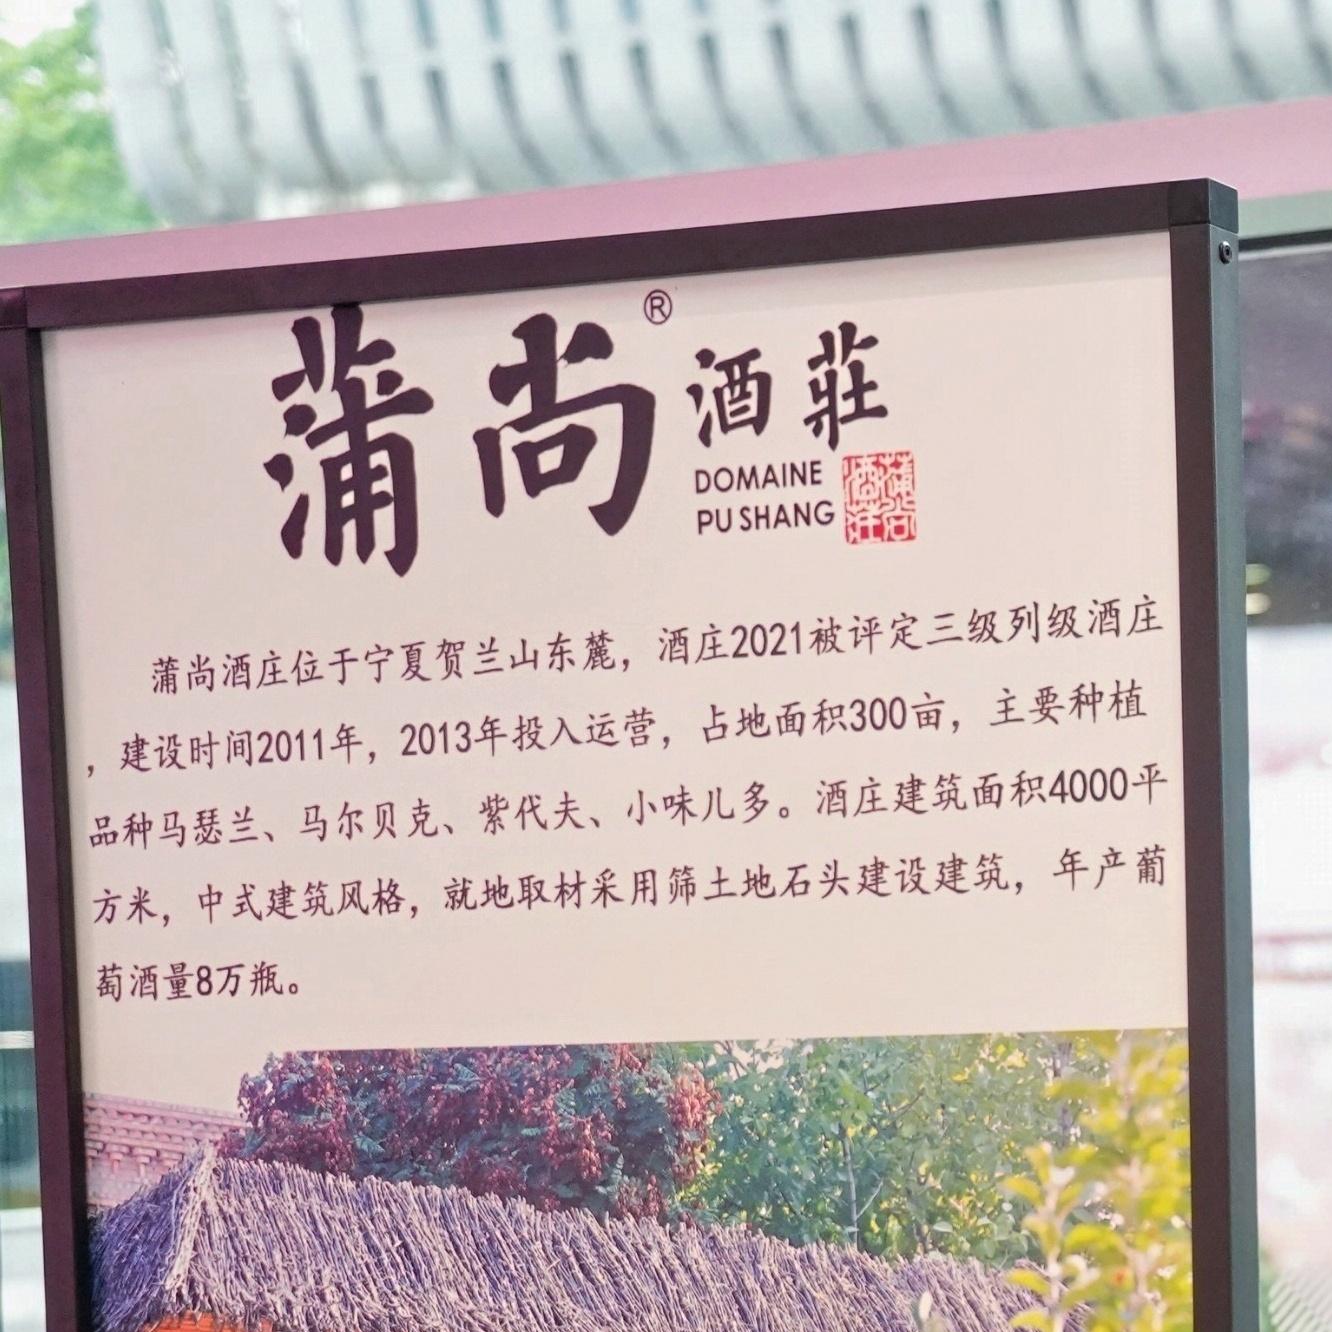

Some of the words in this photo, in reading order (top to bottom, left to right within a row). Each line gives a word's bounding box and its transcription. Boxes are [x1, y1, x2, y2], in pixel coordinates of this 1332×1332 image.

[264, 302, 657, 577] 蒲尚
[686, 321, 888, 451] 酒莊
[694, 459, 823, 495] DOMAINE
[697, 506, 732, 535] PU
[739, 499, 836, 532] SHANG
[96, 961, 300, 1002] 萄酒量8万瓶。
